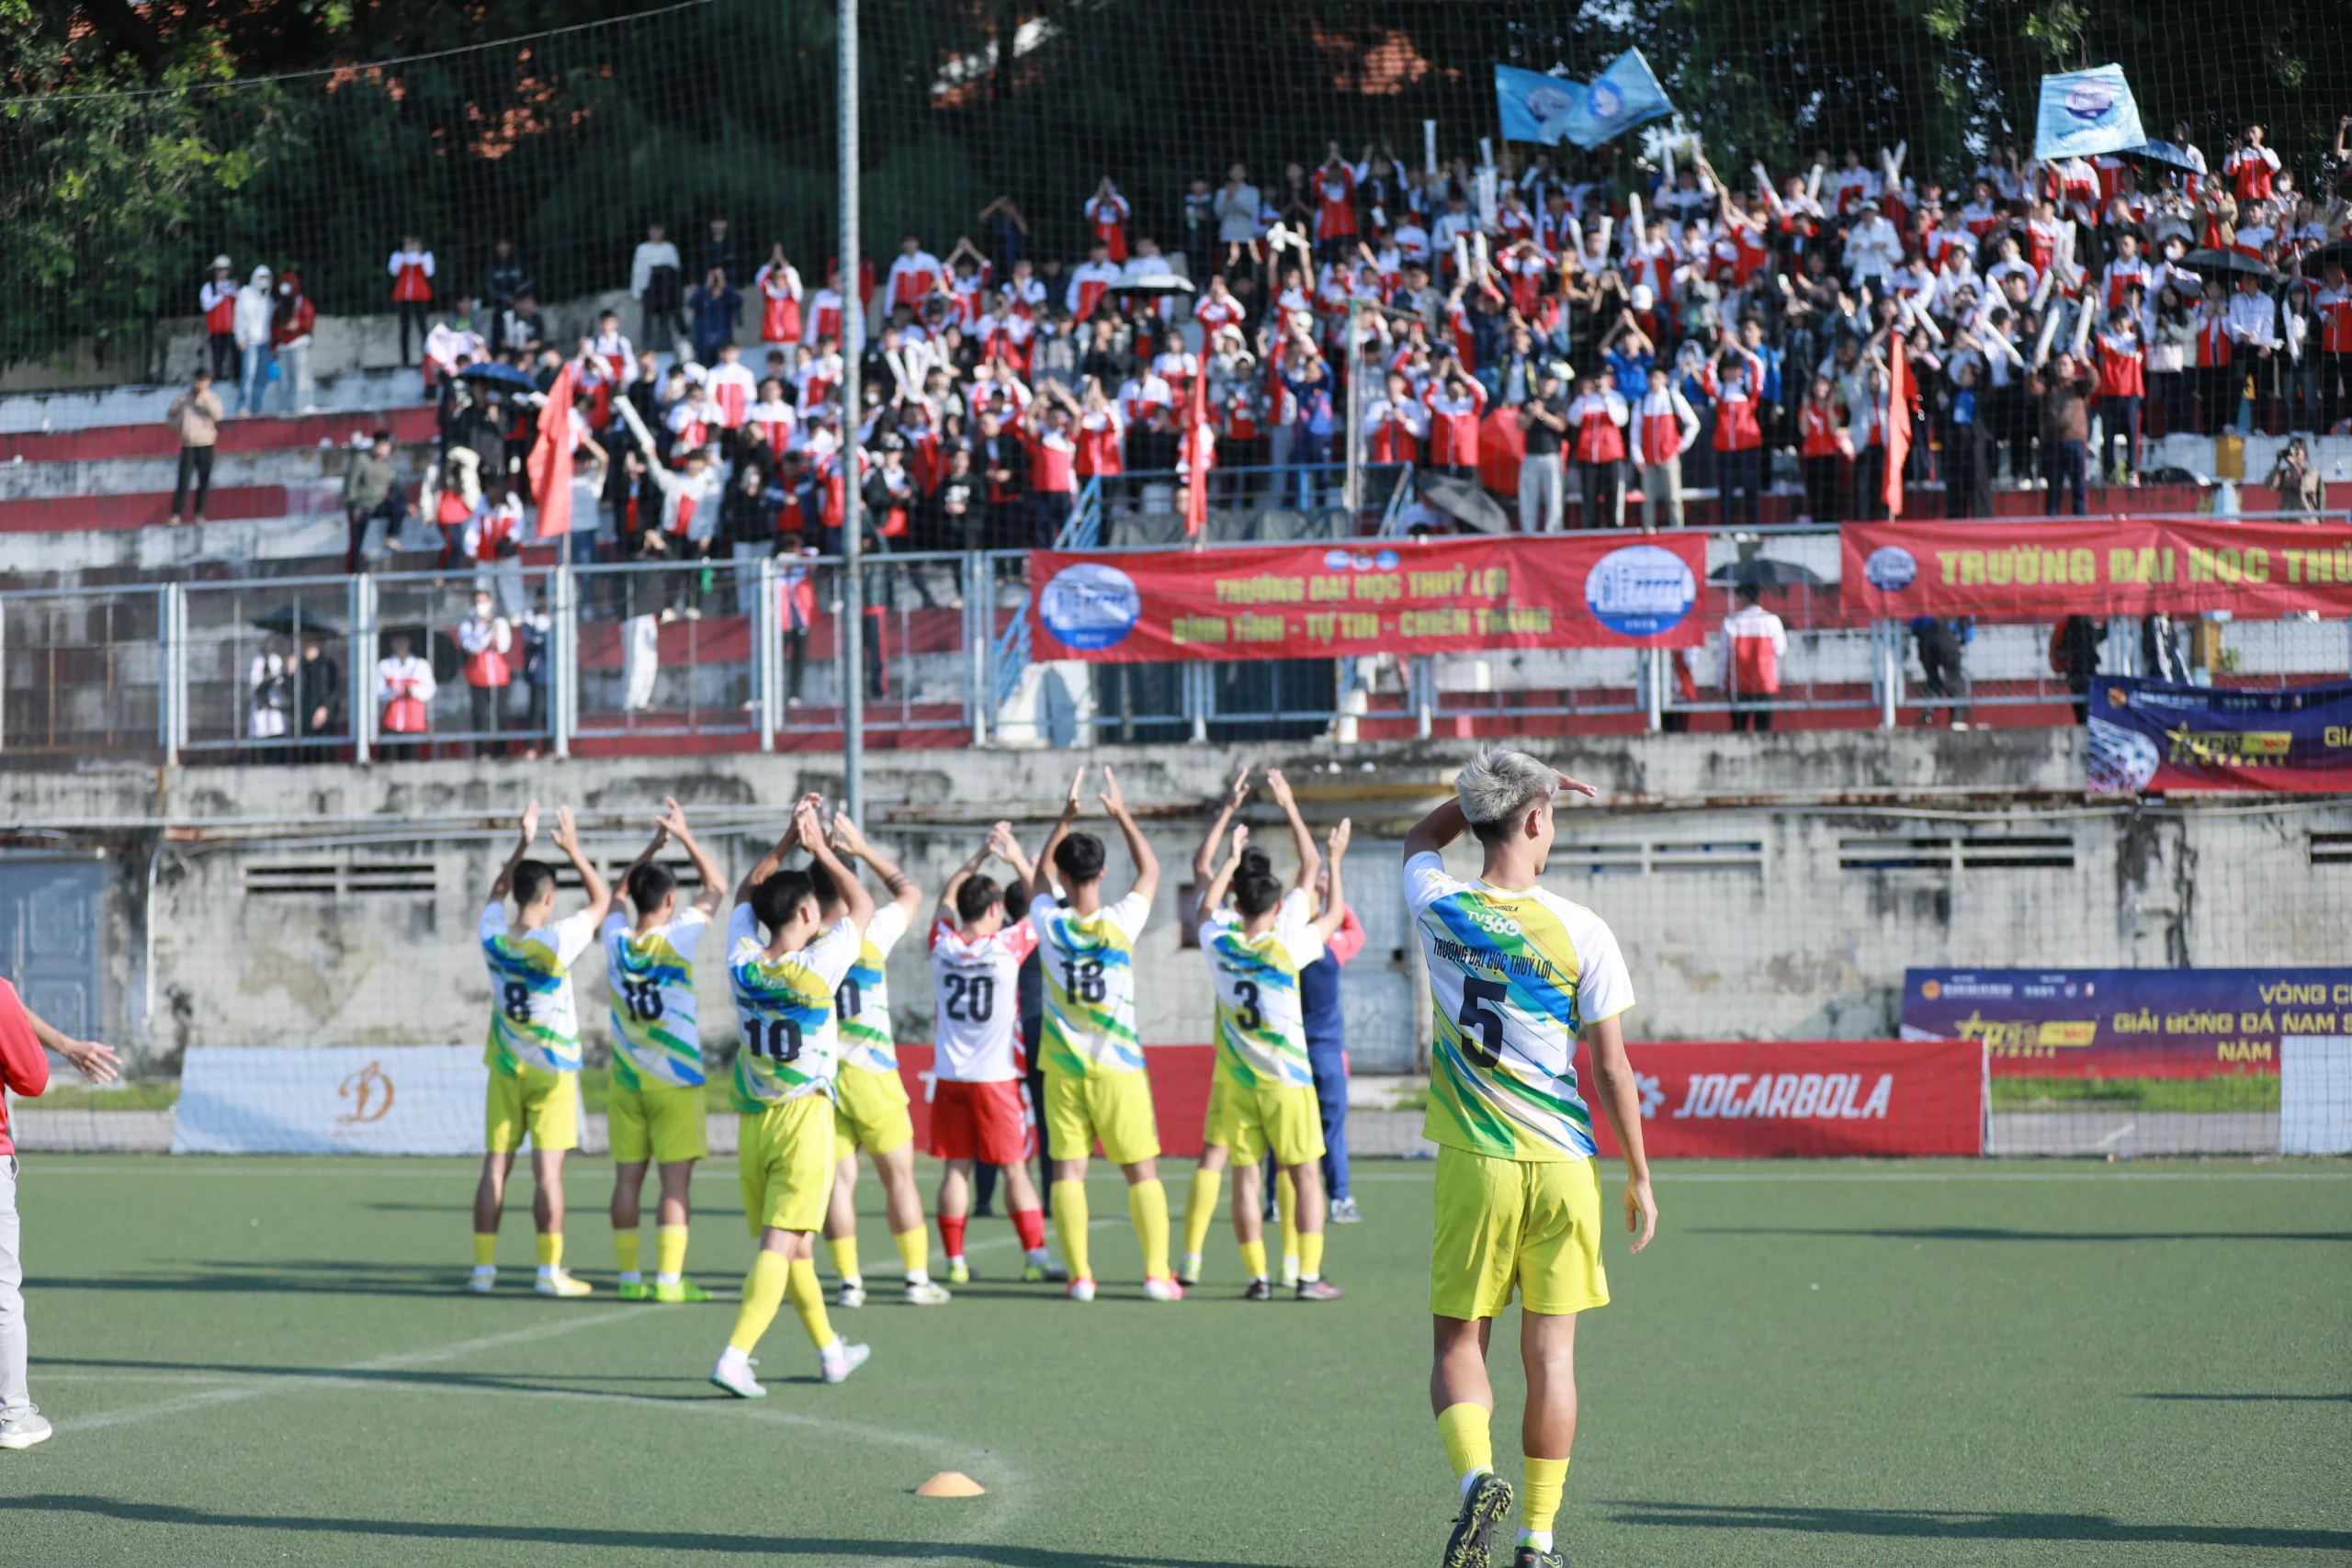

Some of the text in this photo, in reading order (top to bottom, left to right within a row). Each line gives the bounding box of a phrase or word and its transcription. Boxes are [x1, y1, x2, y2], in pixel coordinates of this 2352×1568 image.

[1936, 543, 2096, 585] TRƯỜNG
[2108, 547, 2174, 590] ĐẠI
[2188, 547, 2269, 589] HỌC
[1467, 910, 1521, 937] TV360
[1059, 960, 1107, 1005] 18
[1433, 937, 1553, 984] TRƯỜNG ĐẠI HỌC THUỶ LỢI
[503, 982, 530, 1023] 8
[944, 974, 993, 1022] 20
[1234, 980, 1261, 1031] 3
[2258, 979, 2326, 1005] VÒNG
[744, 1019, 802, 1063] 10
[1458, 976, 1508, 1068] 5
[2112, 1007, 2159, 1034] GIẢI
[2281, 1012, 2335, 1034] NAM
[2217, 1038, 2272, 1062] NĂM
[1673, 1074, 1894, 1119] JOGARBOLA
